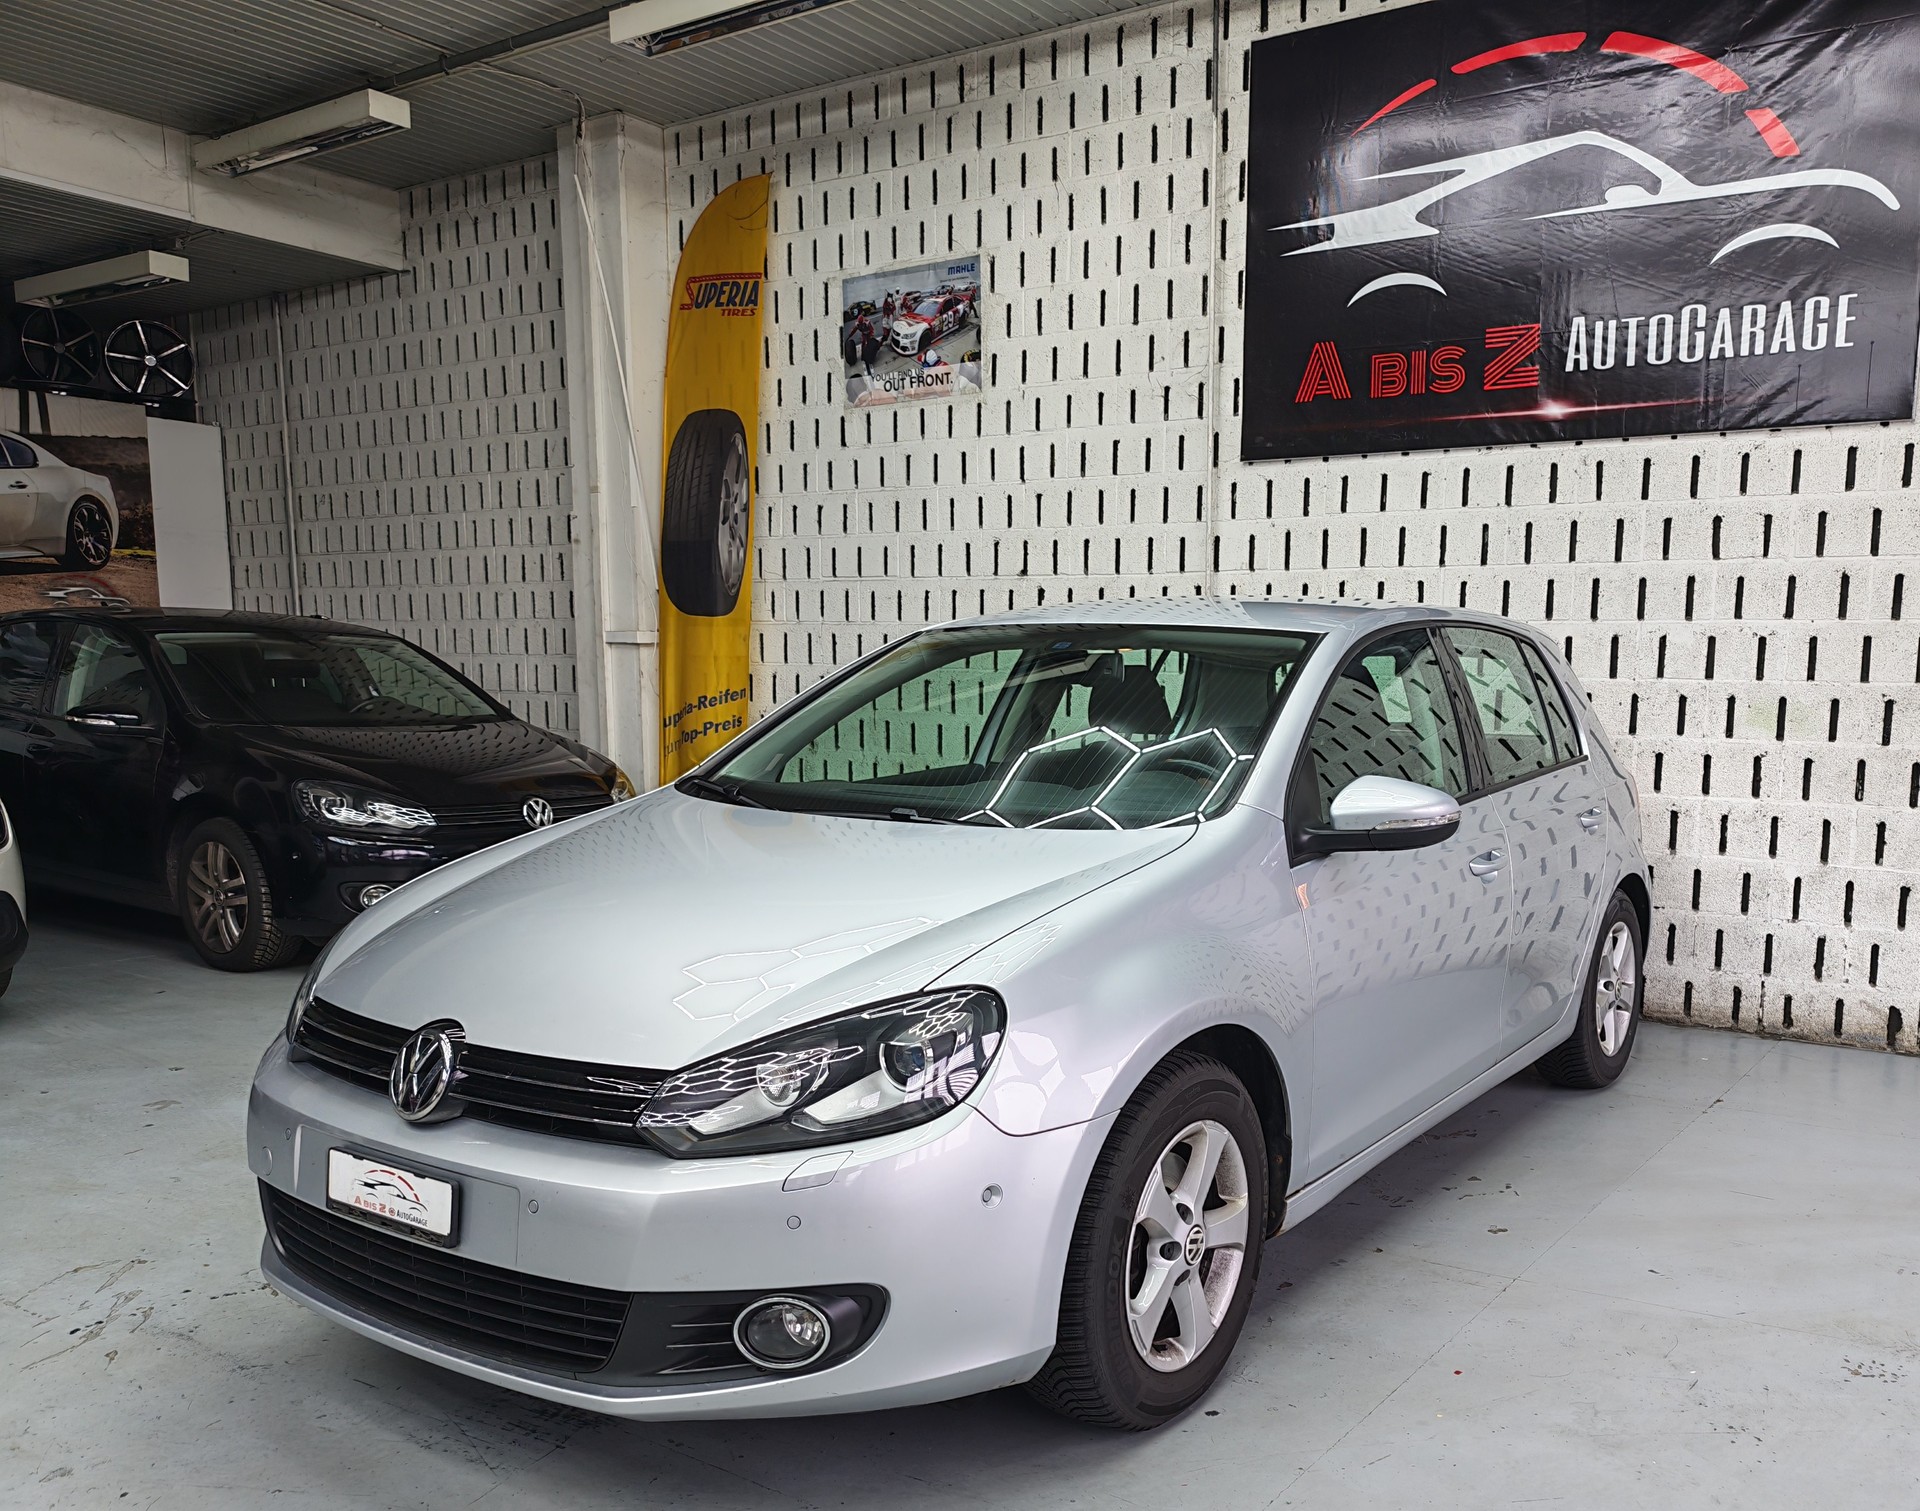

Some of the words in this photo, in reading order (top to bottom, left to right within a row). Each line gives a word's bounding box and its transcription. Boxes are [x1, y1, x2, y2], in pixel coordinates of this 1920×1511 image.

[947, 263, 976, 275] MAHLE
[680, 272, 763, 310] SUPERIA
[721, 308, 757, 317] TIRES
[942, 311, 955, 332] 29
[1294, 341, 1352, 404] A
[1370, 345, 1467, 399] BIS
[1483, 322, 1541, 391] Z
[883, 377, 907, 393] OUT
[909, 371, 954, 389] FRONT.
[663, 688, 746, 728] uperia-Reifen
